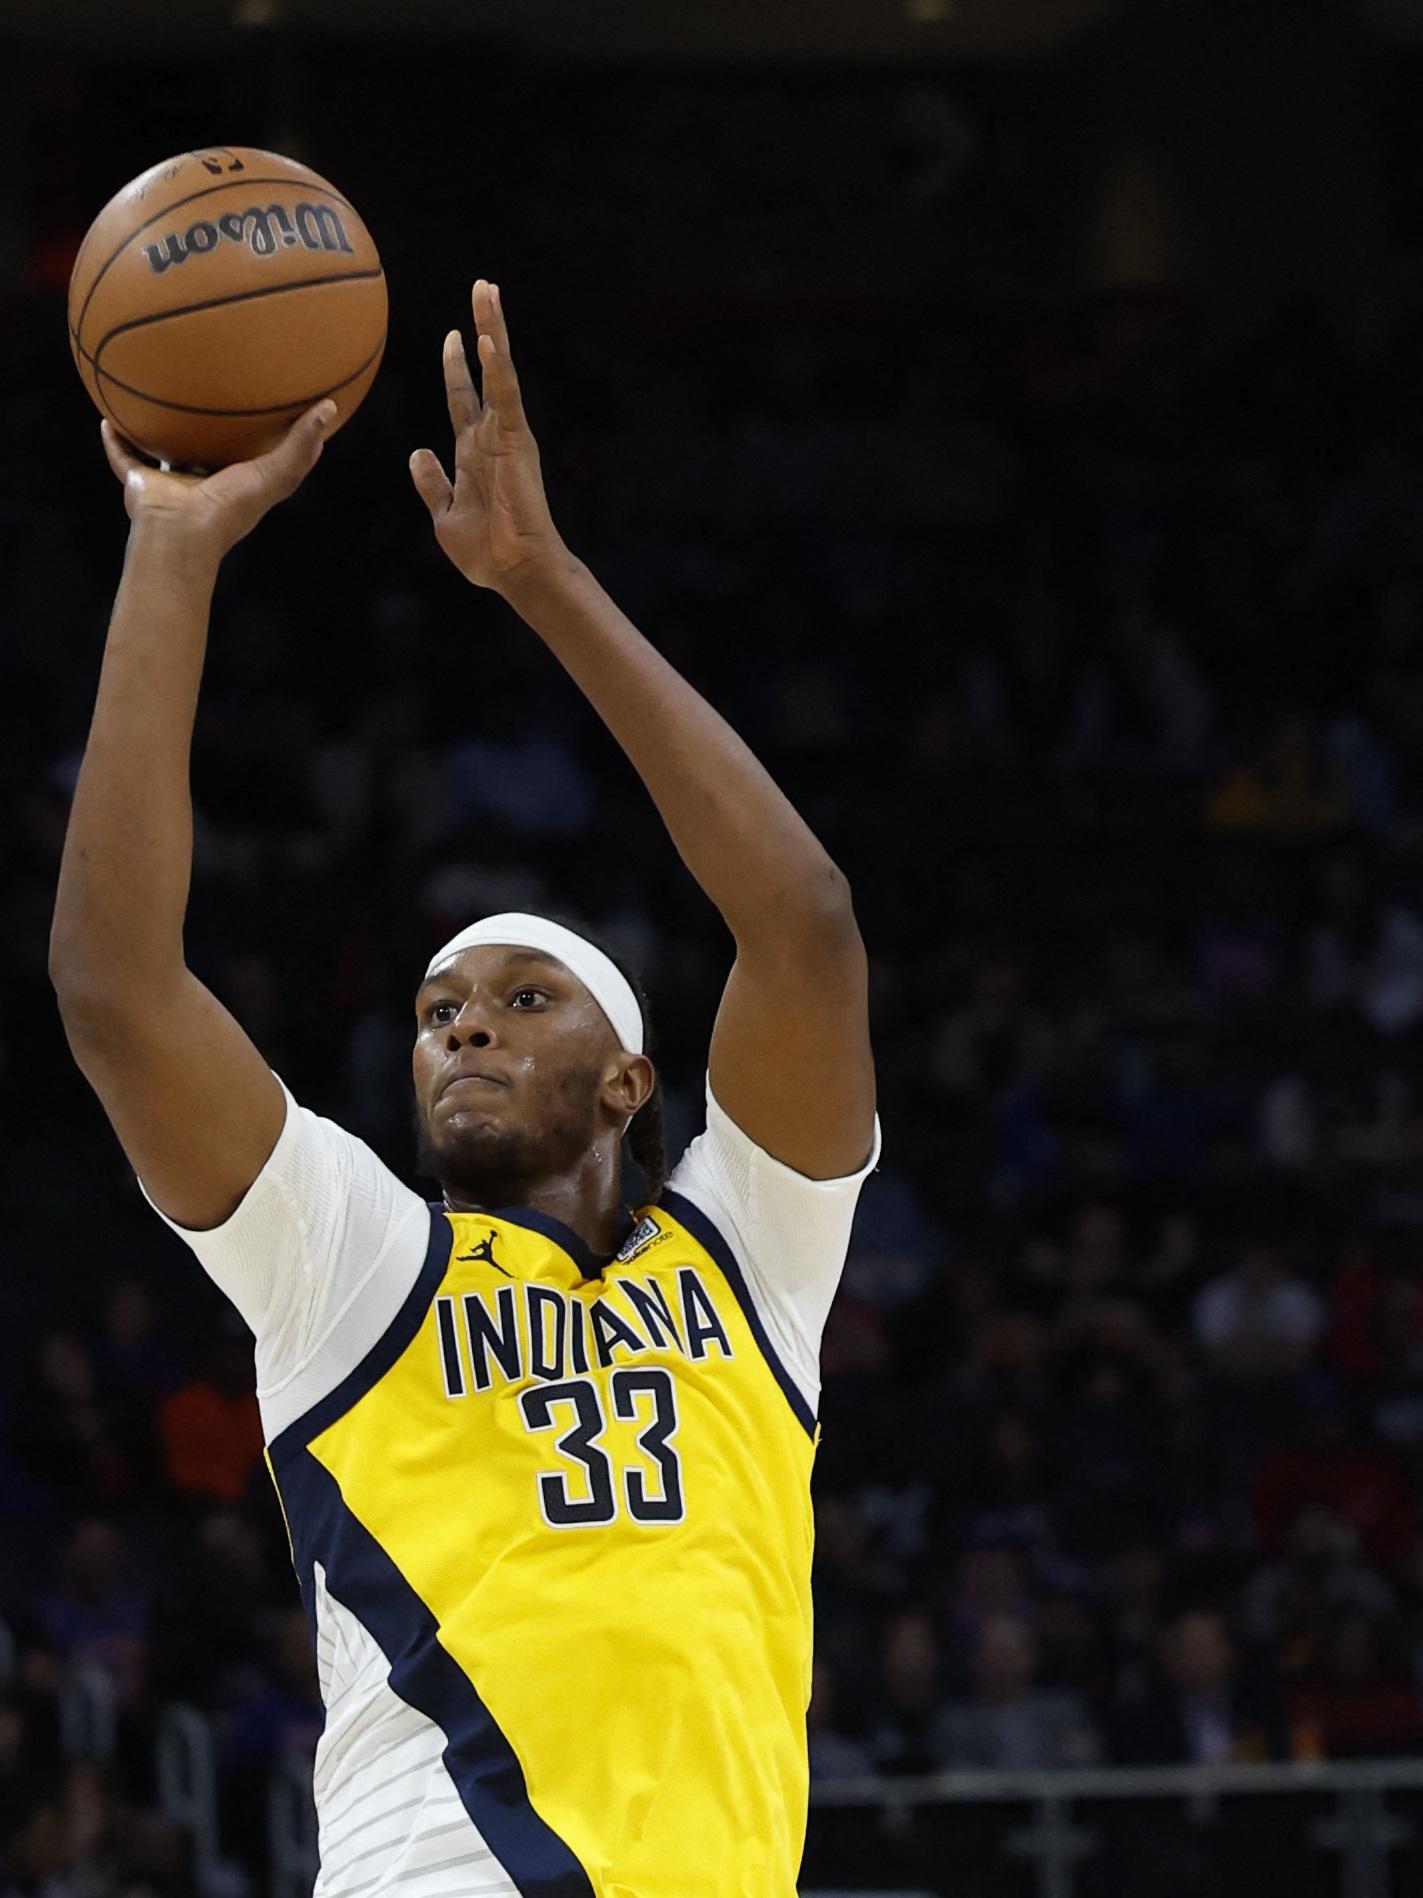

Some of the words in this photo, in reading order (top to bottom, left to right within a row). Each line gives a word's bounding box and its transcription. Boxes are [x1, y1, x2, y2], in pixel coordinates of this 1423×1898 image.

[142, 203, 353, 272] Wilson
[435, 1264, 734, 1399] INDIANA
[516, 1365, 686, 1529] 33
